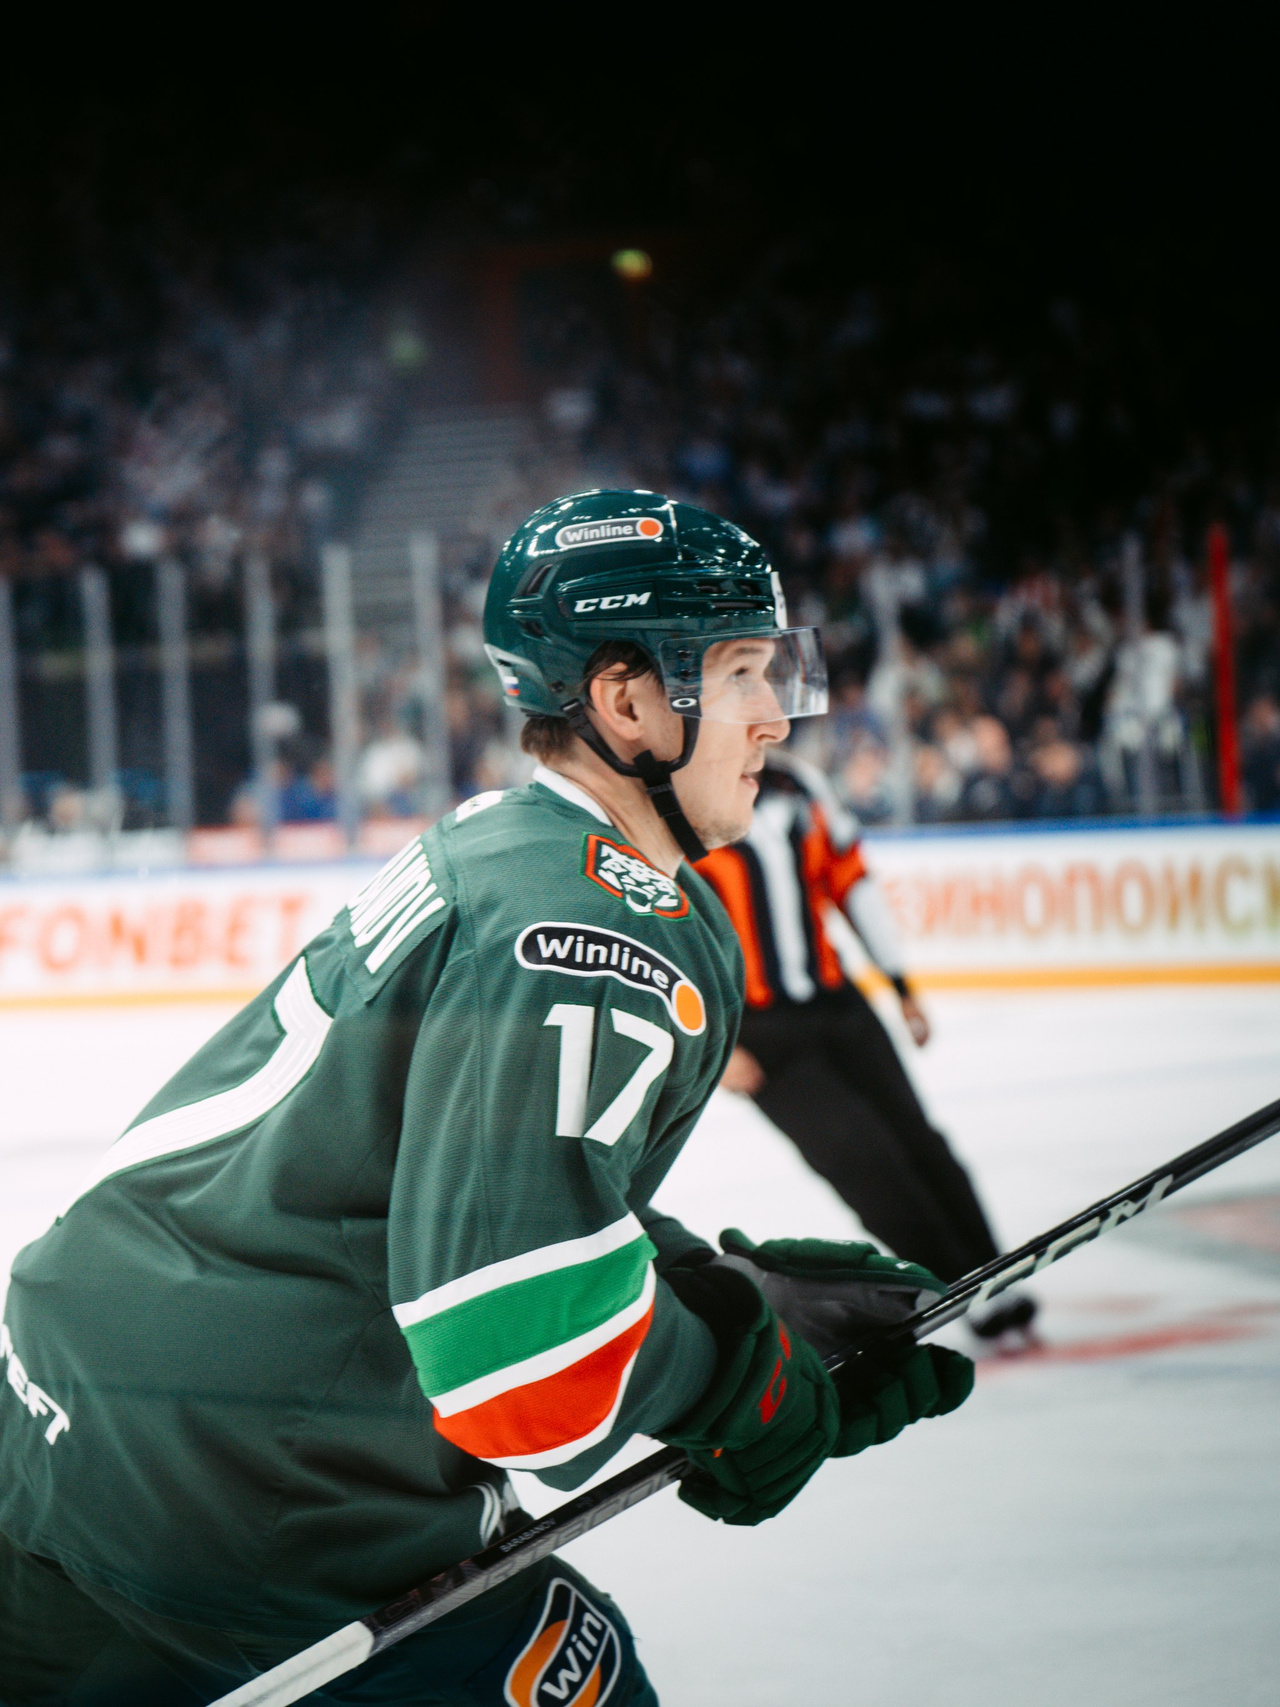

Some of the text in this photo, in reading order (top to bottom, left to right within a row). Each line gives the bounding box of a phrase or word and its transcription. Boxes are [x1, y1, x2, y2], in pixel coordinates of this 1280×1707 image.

[564, 523, 634, 544] Winline
[573, 591, 652, 614] CCM
[535, 933, 671, 991] Winline
[543, 1003, 675, 1147] 17
